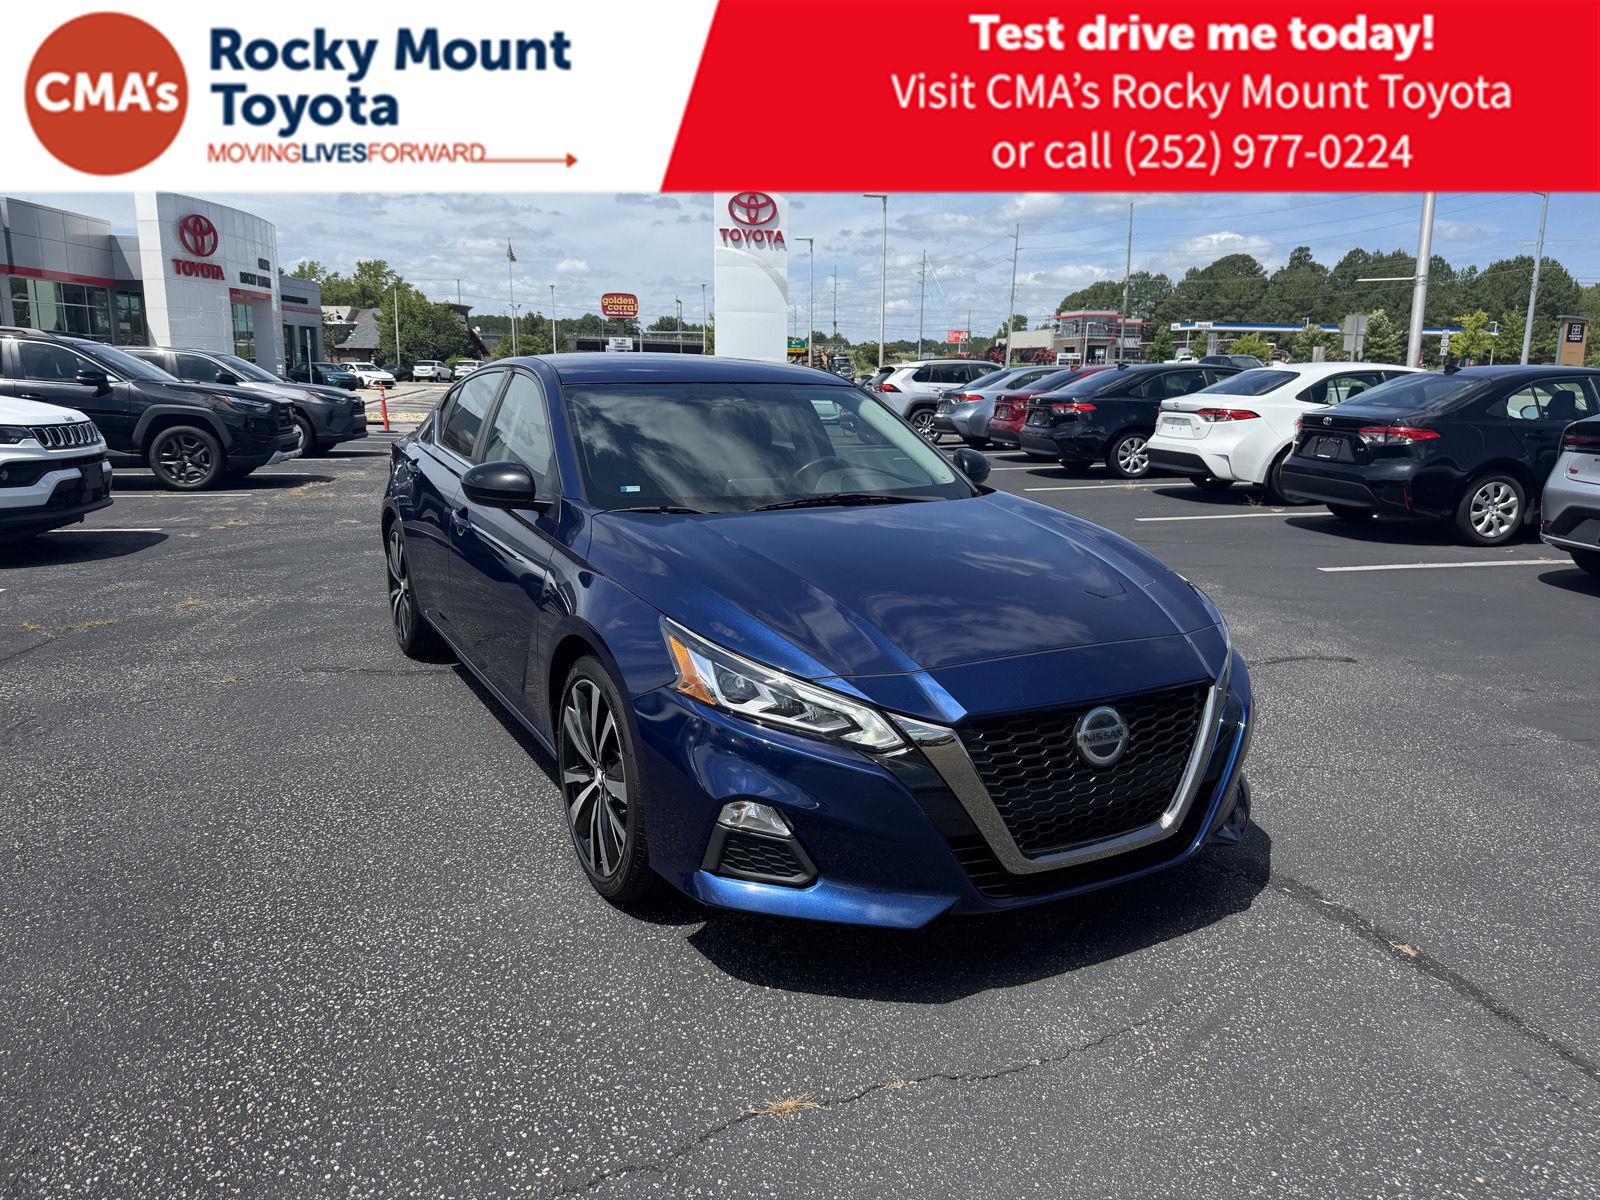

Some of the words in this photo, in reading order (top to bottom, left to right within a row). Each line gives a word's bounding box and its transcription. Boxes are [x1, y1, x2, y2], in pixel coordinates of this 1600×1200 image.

[719, 228, 785, 244] TOYOTA
[172, 258, 225, 281] TOYOTA
[602, 296, 635, 306] golden
[607, 303, 638, 311] corral
[1083, 725, 1124, 744] NISSAN
